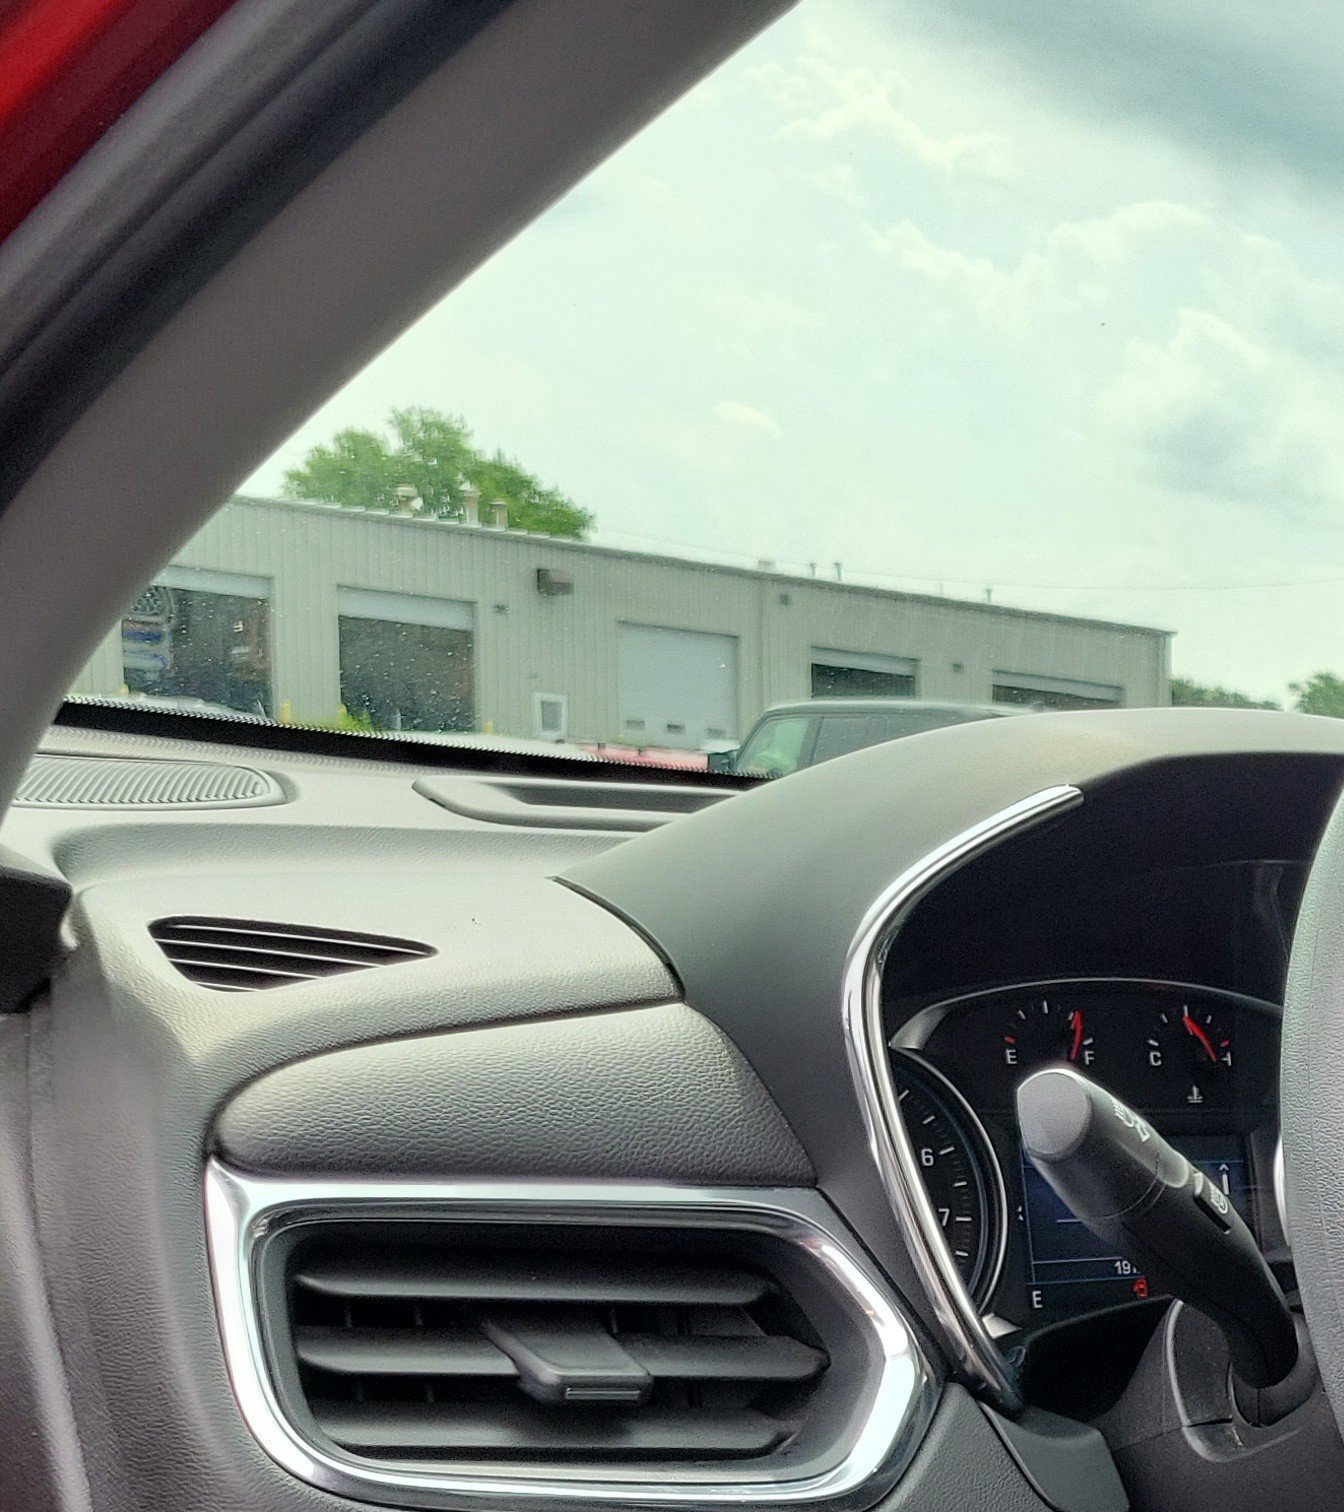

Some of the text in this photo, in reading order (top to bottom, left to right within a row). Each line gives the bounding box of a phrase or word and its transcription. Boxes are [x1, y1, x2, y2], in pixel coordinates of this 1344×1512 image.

[1006, 1049, 1017, 1065] E
[1084, 1051, 1095, 1066] F
[1150, 1052, 1162, 1066] C
[921, 1148, 934, 1166] 6
[938, 1208, 950, 1227] 7
[1115, 1260, 1138, 1275] 19
[1032, 1290, 1043, 1309] E
